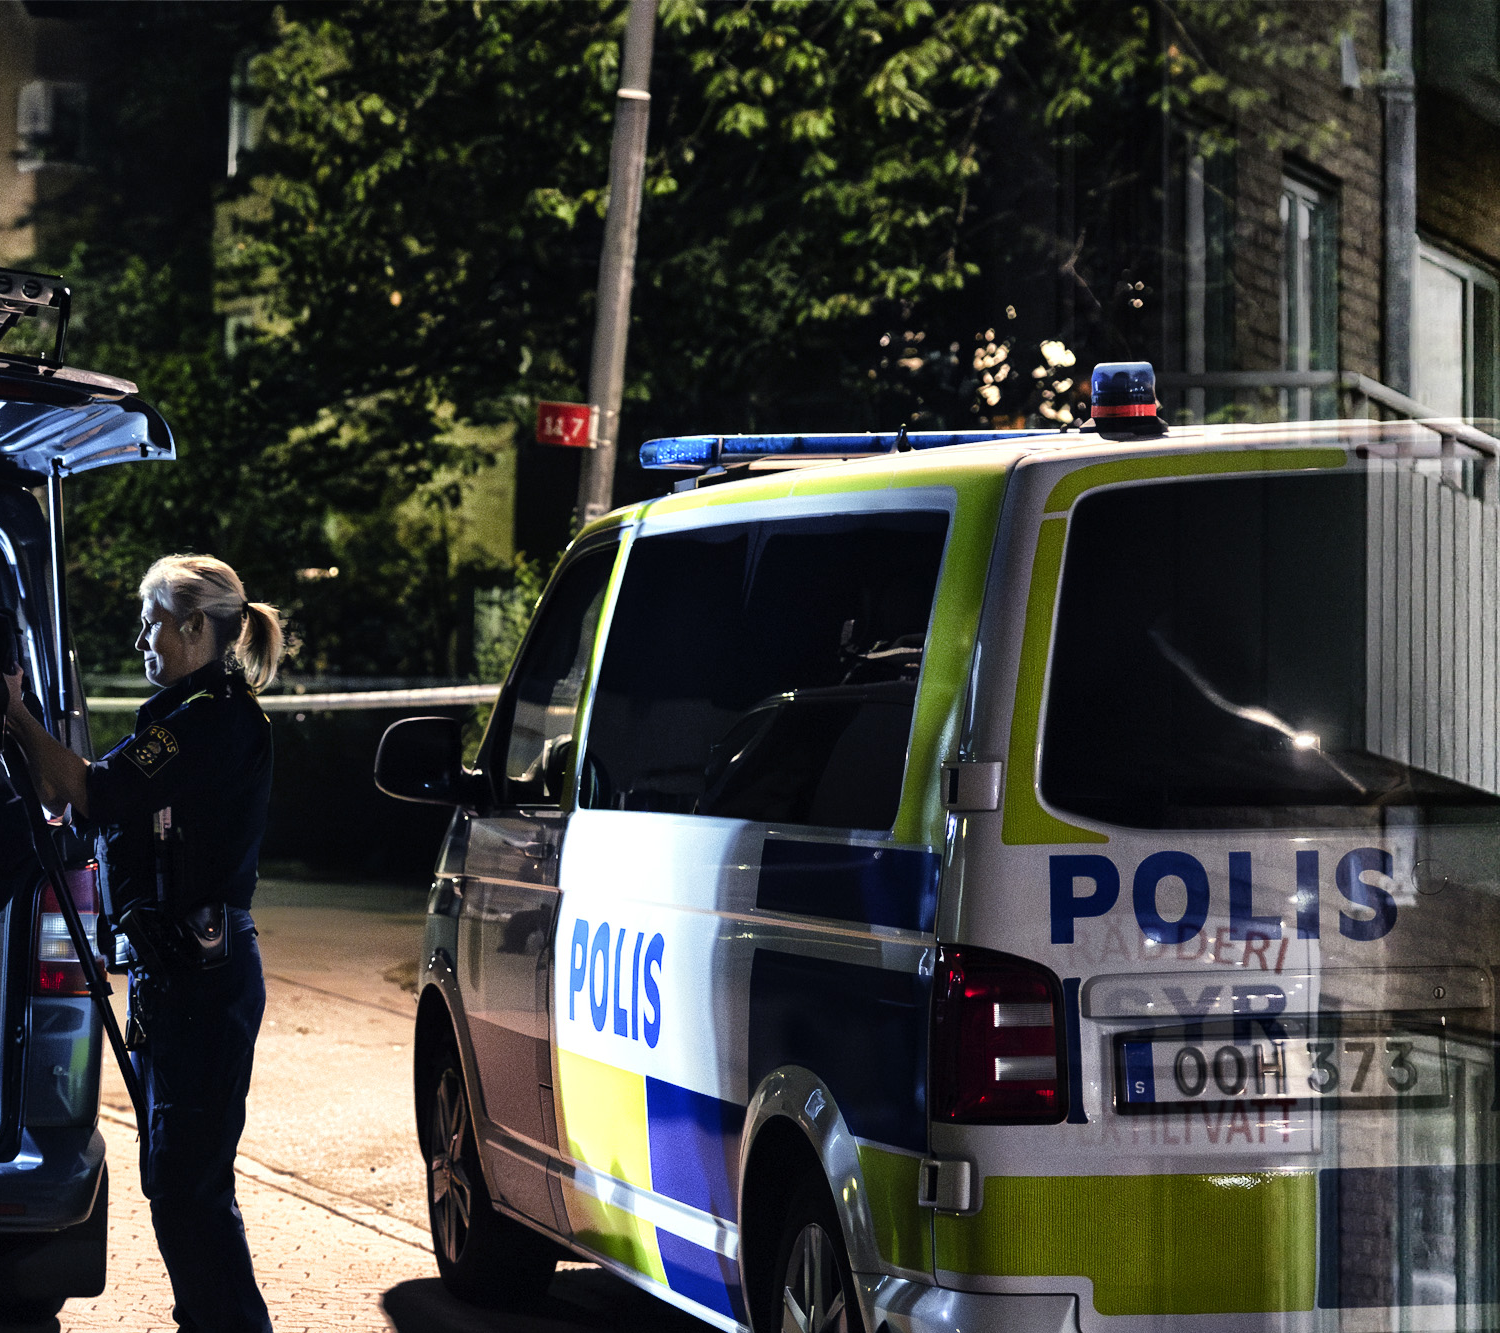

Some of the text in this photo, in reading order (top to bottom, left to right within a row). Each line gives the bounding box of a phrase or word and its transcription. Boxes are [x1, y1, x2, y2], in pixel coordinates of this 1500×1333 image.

[150, 728, 177, 753] POLIS
[1048, 847, 1398, 945] POLIS
[569, 918, 665, 1049] POLIS
[1135, 1081, 1145, 1094] S
[1174, 1041, 1418, 1098] OOH 373
